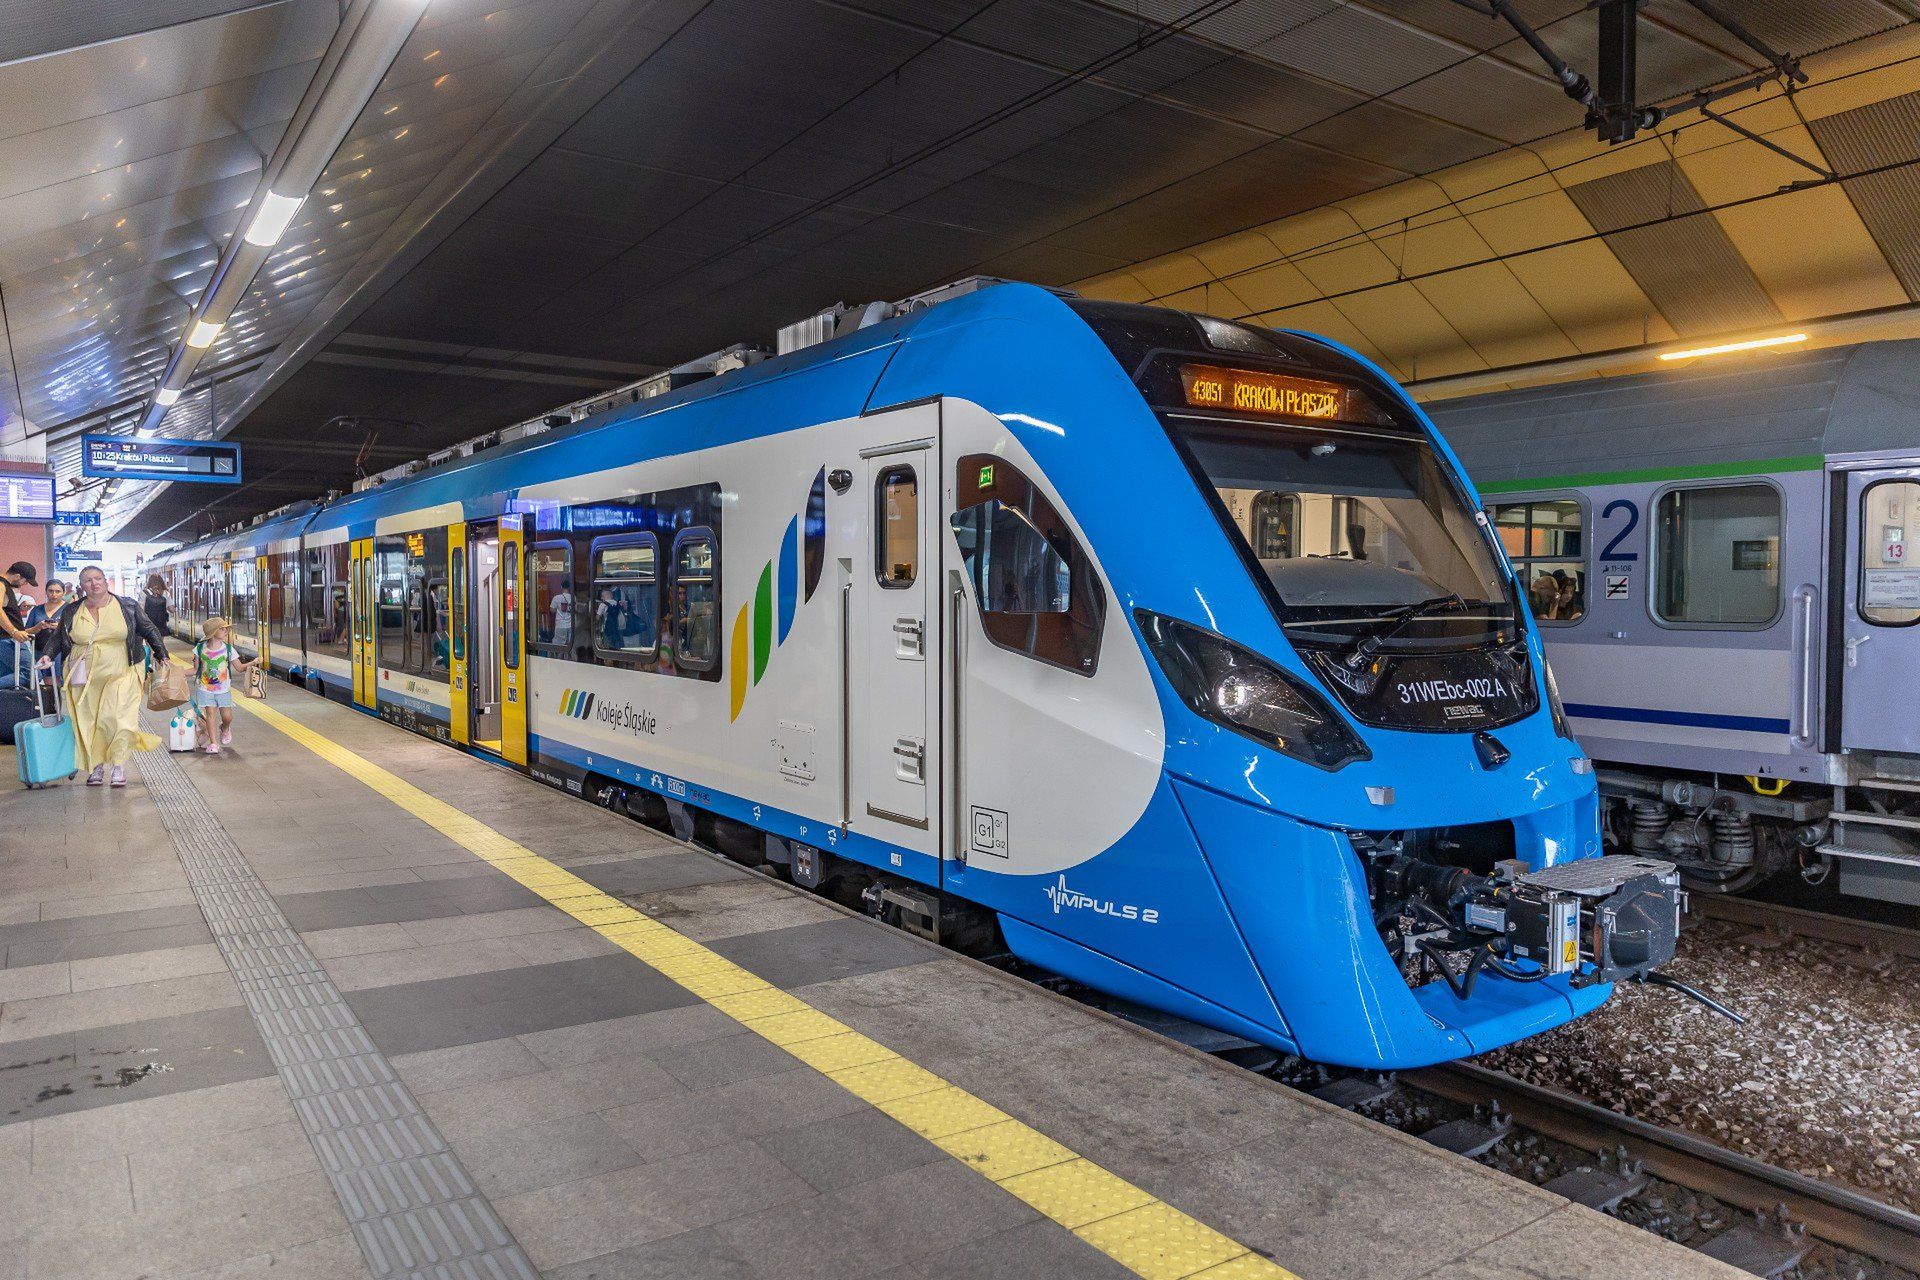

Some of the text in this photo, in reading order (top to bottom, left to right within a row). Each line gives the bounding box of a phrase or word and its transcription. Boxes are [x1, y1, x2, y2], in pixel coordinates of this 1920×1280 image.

[1234, 383, 1284, 412] KRAKÓW
[92, 451, 116, 461] 10:25
[1599, 499, 1639, 562] 2
[1887, 544, 1903, 558] 13
[596, 699, 656, 737] Koleje Śląskie
[978, 823, 992, 838] G1
[1142, 908, 1160, 924] 2
